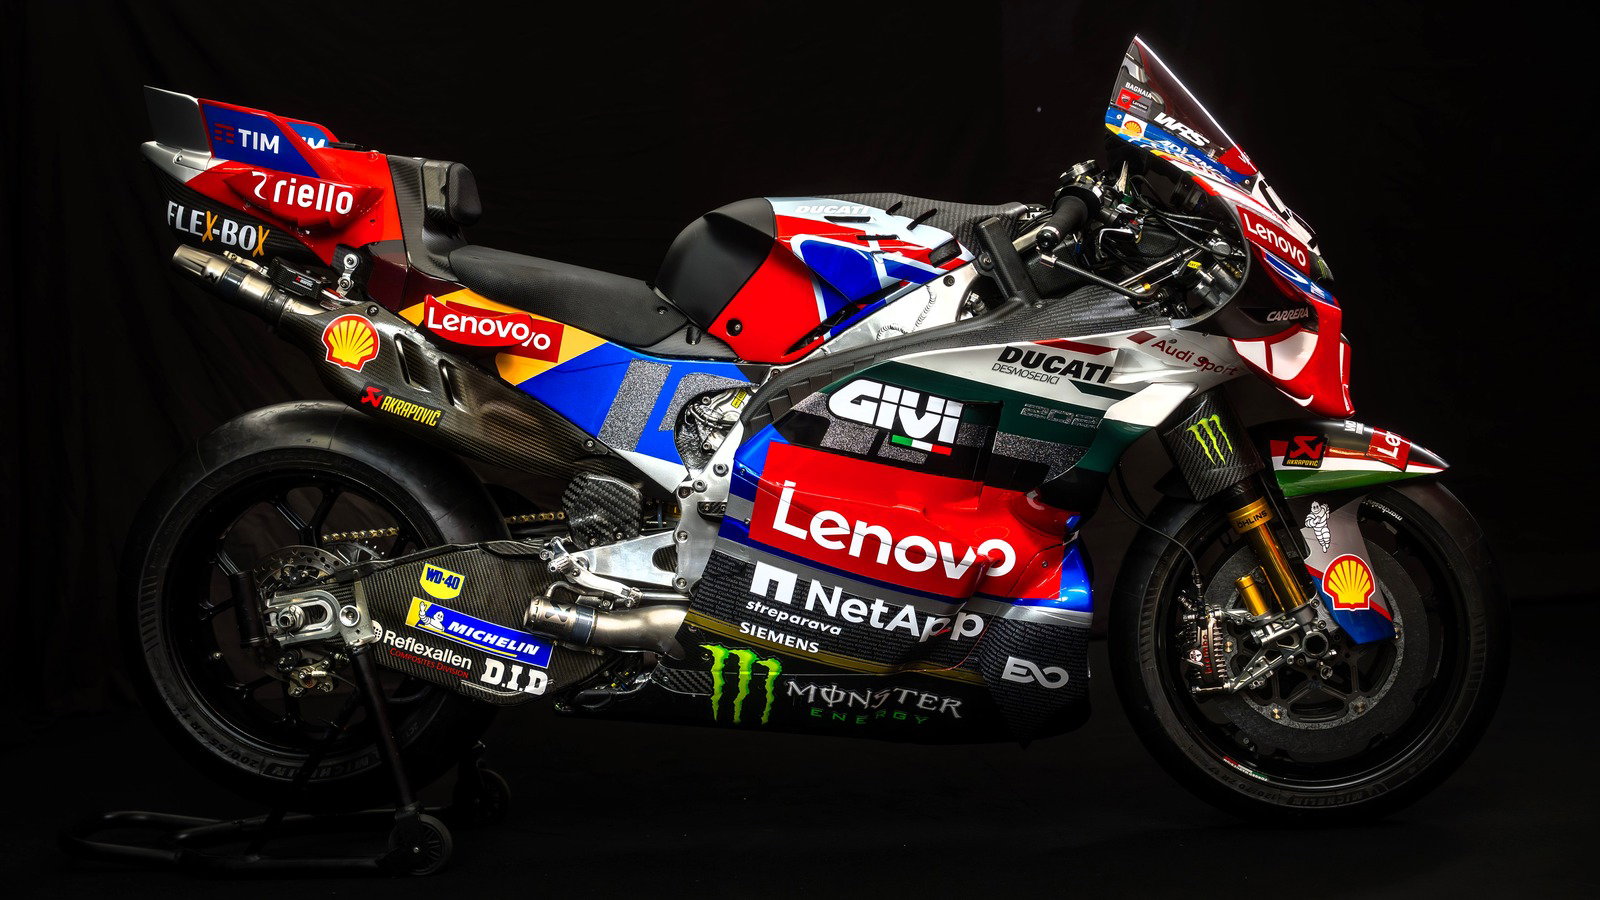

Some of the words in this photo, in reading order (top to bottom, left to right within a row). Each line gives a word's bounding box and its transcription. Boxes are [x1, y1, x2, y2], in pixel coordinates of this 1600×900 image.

[1125, 82, 1152, 99] BAGNAIA
[238, 128, 280, 154] TIM
[1154, 112, 1210, 146] WRS
[273, 177, 353, 215] riello
[795, 205, 869, 215] DUCATI
[167, 200, 270, 256] FLEX-BOX
[1243, 212, 1306, 267] Lenovo
[427, 306, 529, 341] Lenovo
[1267, 307, 1309, 322] CARRERA
[991, 362, 1060, 385] DESMOSEDICI
[997, 346, 1114, 385] DUCATI
[1151, 338, 1193, 362] Audi
[1193, 356, 1237, 376] Sport
[772, 480, 1016, 580] Lenovo
[426, 567, 461, 590] WD-40
[745, 599, 842, 636] streparava
[804, 578, 984, 643] NetApp
[383, 629, 472, 670] Reflexallen
[447, 621, 541, 656] MICHELIN
[739, 621, 820, 653] SIEMENS
[389, 648, 436, 669] COMPOSITES
[436, 661, 469, 679] DIVISION
[786, 679, 965, 719] MONSTER
[809, 707, 929, 725] ENERGY
